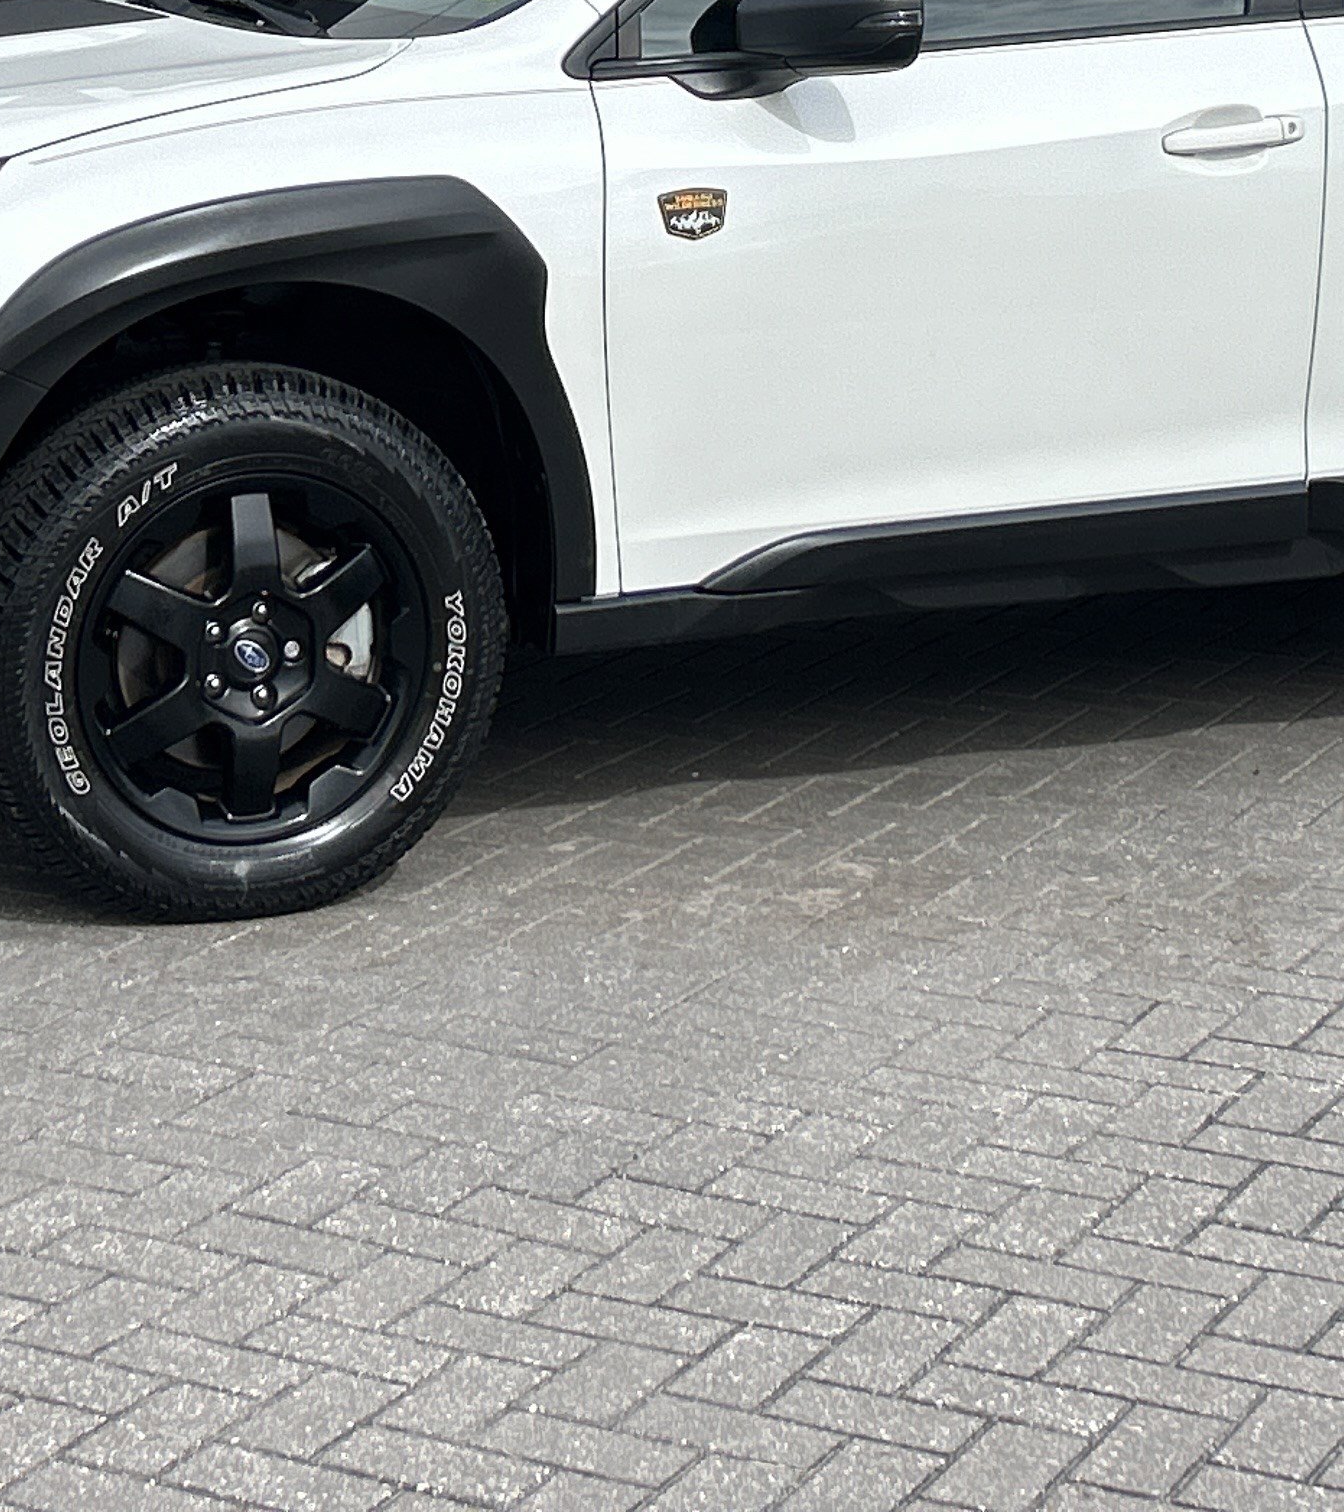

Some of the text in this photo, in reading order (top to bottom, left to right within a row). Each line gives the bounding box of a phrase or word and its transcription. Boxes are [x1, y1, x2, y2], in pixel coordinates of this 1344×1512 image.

[43, 462, 178, 795] GEOLANDAR A/T
[390, 589, 469, 802] YOKOHAMA
